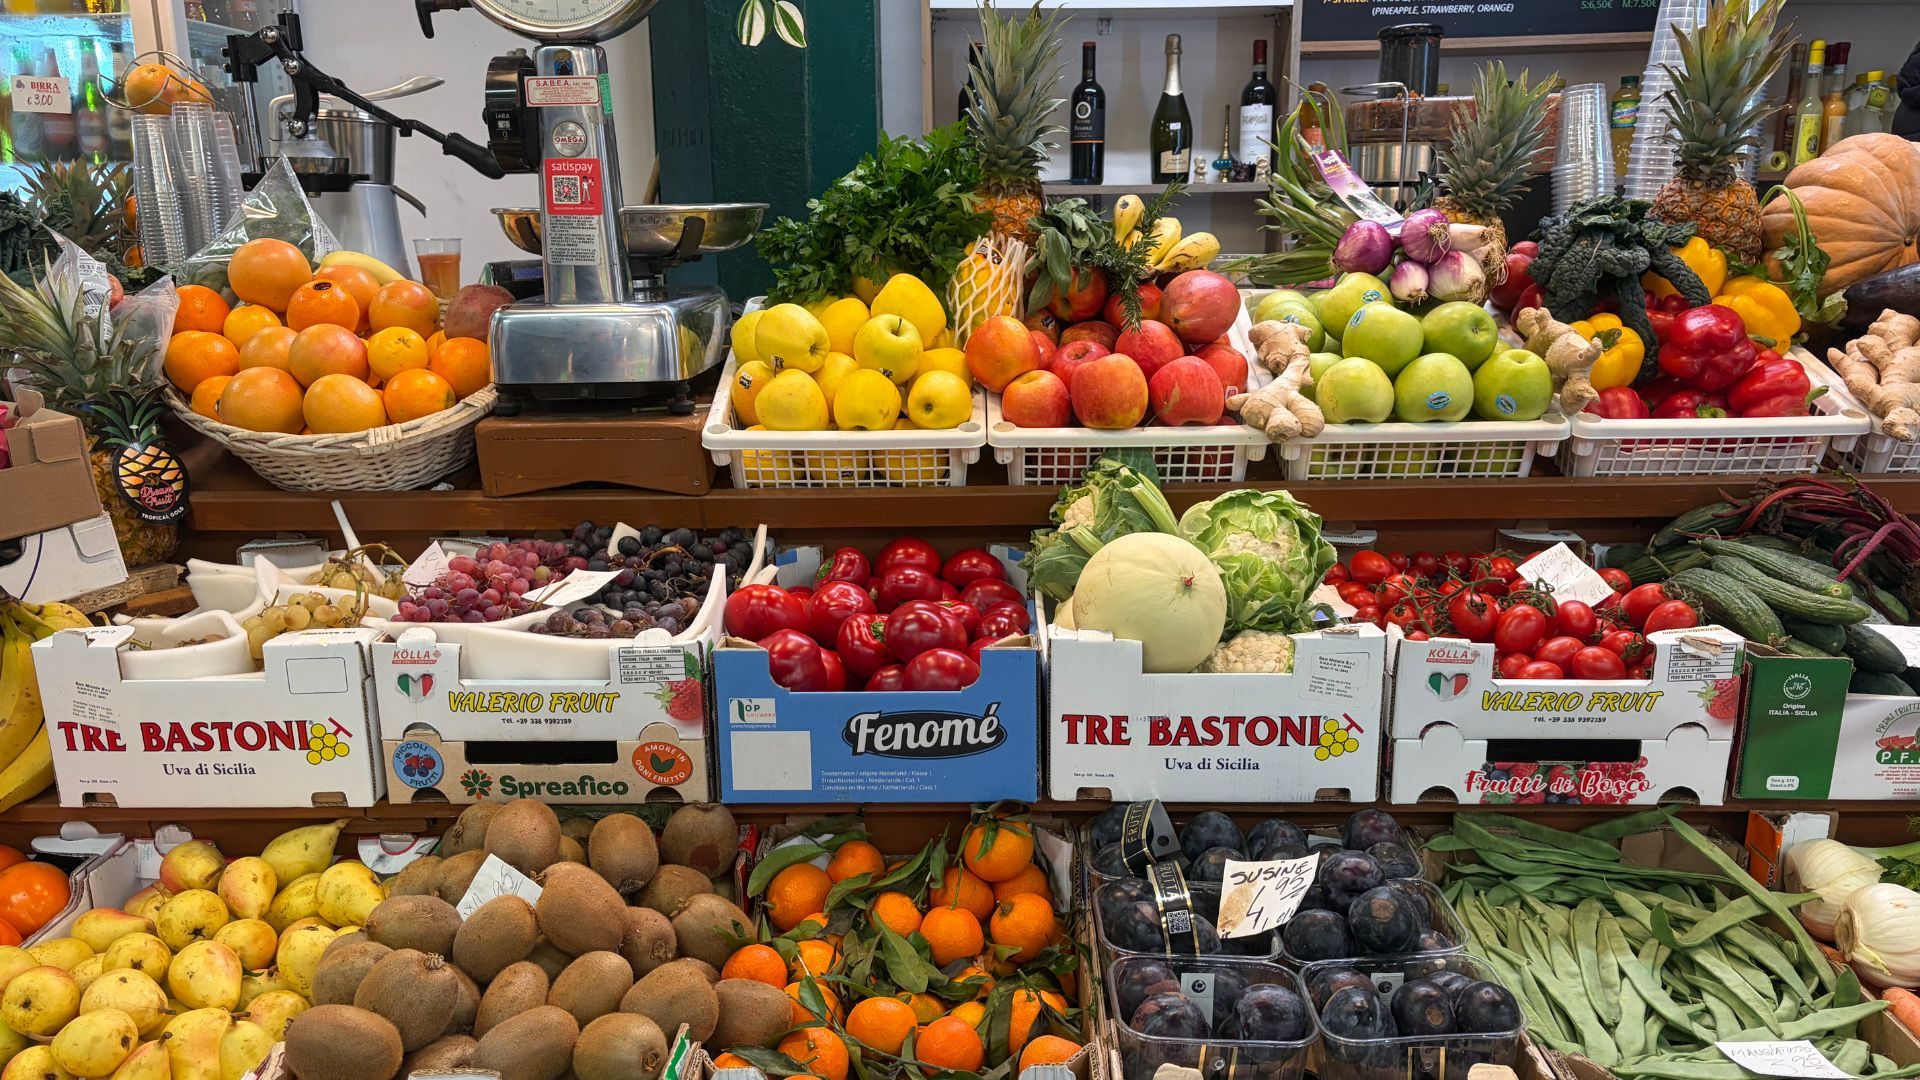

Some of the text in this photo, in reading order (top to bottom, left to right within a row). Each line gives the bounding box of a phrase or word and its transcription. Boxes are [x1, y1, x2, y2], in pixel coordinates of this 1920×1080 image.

[1372, 3, 1514, 16] (PINEAPPLE, STRAWBERRY, ORANGE)
[30, 81, 59, 90] BIRRA
[551, 161, 593, 174] satispay
[141, 506, 184, 521] TROPICAL GOLD
[393, 648, 431, 660] KÖLLA
[1428, 648, 1468, 659] KÖLLA
[1788, 673, 1809, 681] ITALIA
[449, 691, 620, 714] VALERIO FRUIT
[1481, 690, 1664, 713] VALERIO FRUIT
[849, 702, 1002, 753] Fenomé
[1061, 714, 1322, 747] TRE BASTONI
[1876, 712, 1896, 734] PRIMI
[57, 719, 310, 752] TRE BASTONI
[395, 742, 428, 760] PICCOLI
[643, 743, 687, 764] AMORE IN
[163, 762, 256, 776] Uva di Sicilia
[634, 759, 687, 783] OGNI FRUTTO
[1164, 757, 1260, 771] Uva di Sicilia
[408, 772, 440, 787] FRUTTI
[499, 774, 630, 799] Spreafico
[1465, 769, 1654, 796] Frutti di Bosco
[1230, 860, 1311, 886] SUSINE
